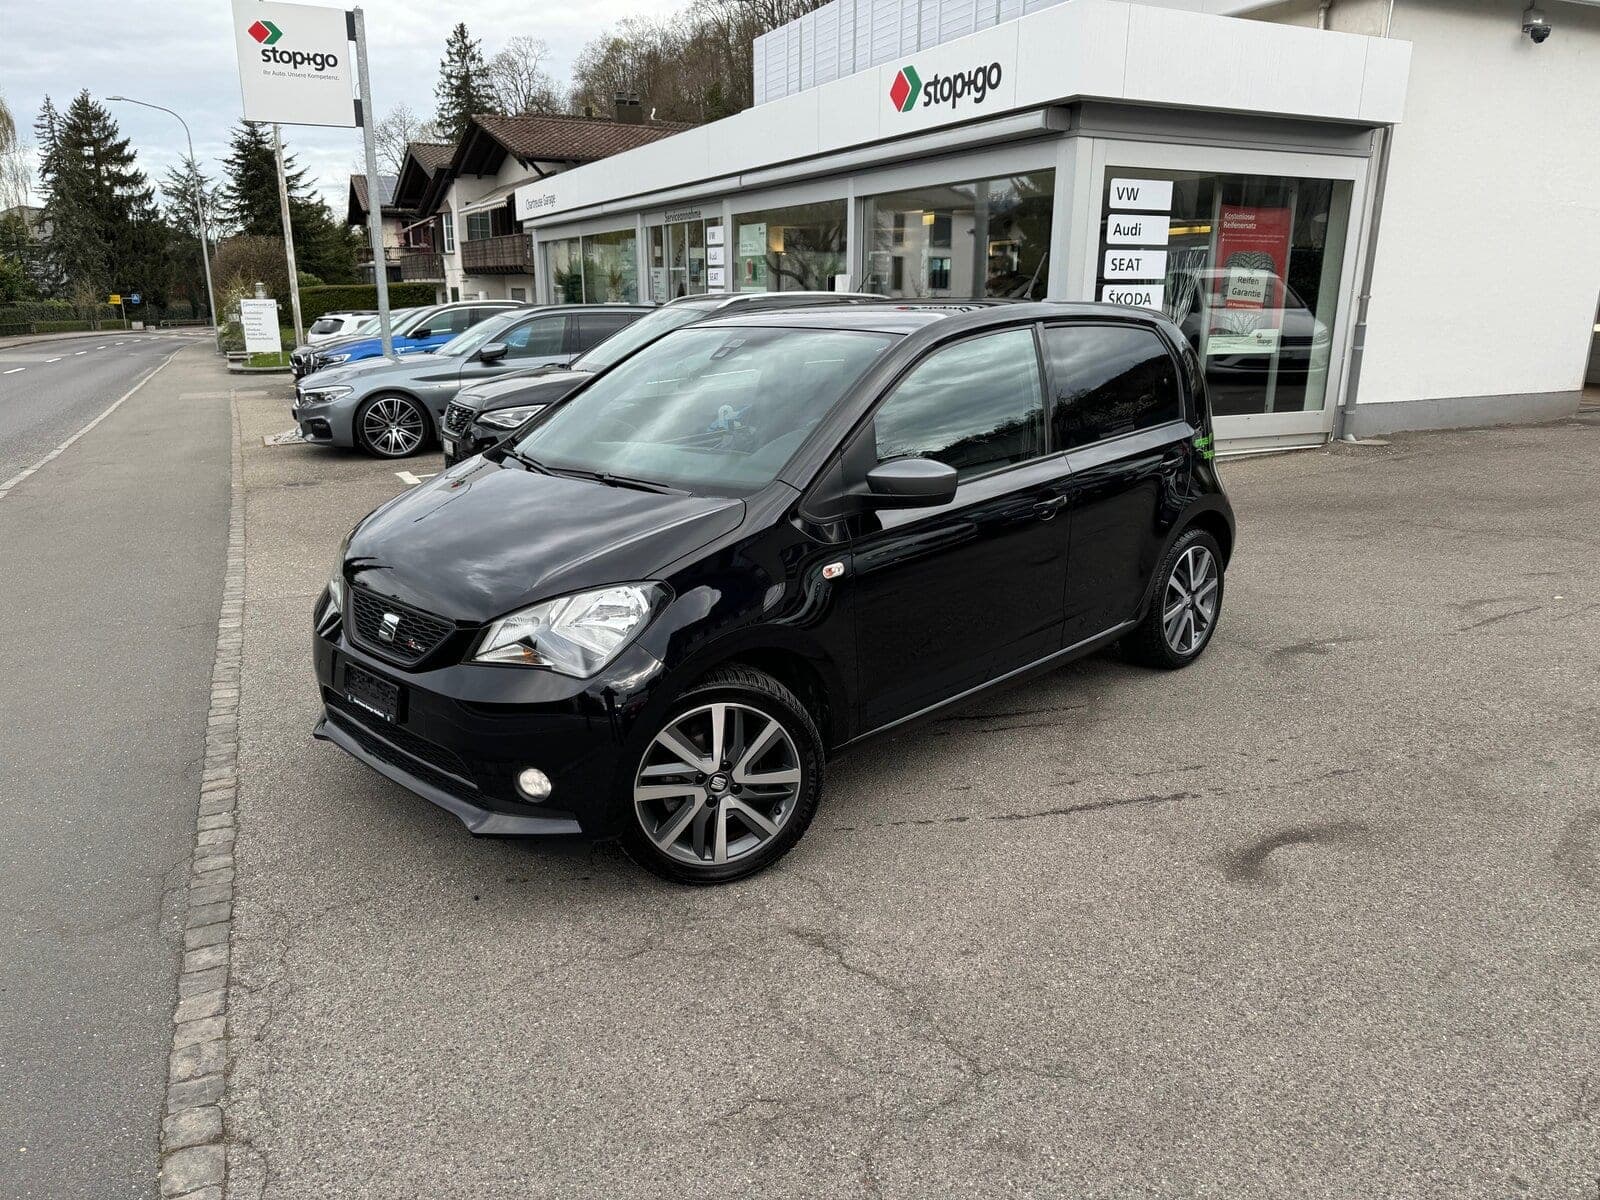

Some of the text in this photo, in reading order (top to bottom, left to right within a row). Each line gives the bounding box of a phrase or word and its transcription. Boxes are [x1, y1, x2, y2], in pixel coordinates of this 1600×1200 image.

[261, 46, 338, 71] stop+go
[307, 73, 340, 81] Kompetenz.
[923, 62, 1002, 109] stop+go
[1116, 186, 1140, 201] VW
[1224, 212, 1256, 221] Kostenloser
[1113, 223, 1142, 237] Audi
[1223, 221, 1257, 230] Reifenersatz
[1110, 258, 1142, 272] SEAT
[1237, 276, 1260, 285] Reifen
[1108, 289, 1152, 305] ŠKODA
[1231, 287, 1262, 298] Garantie
